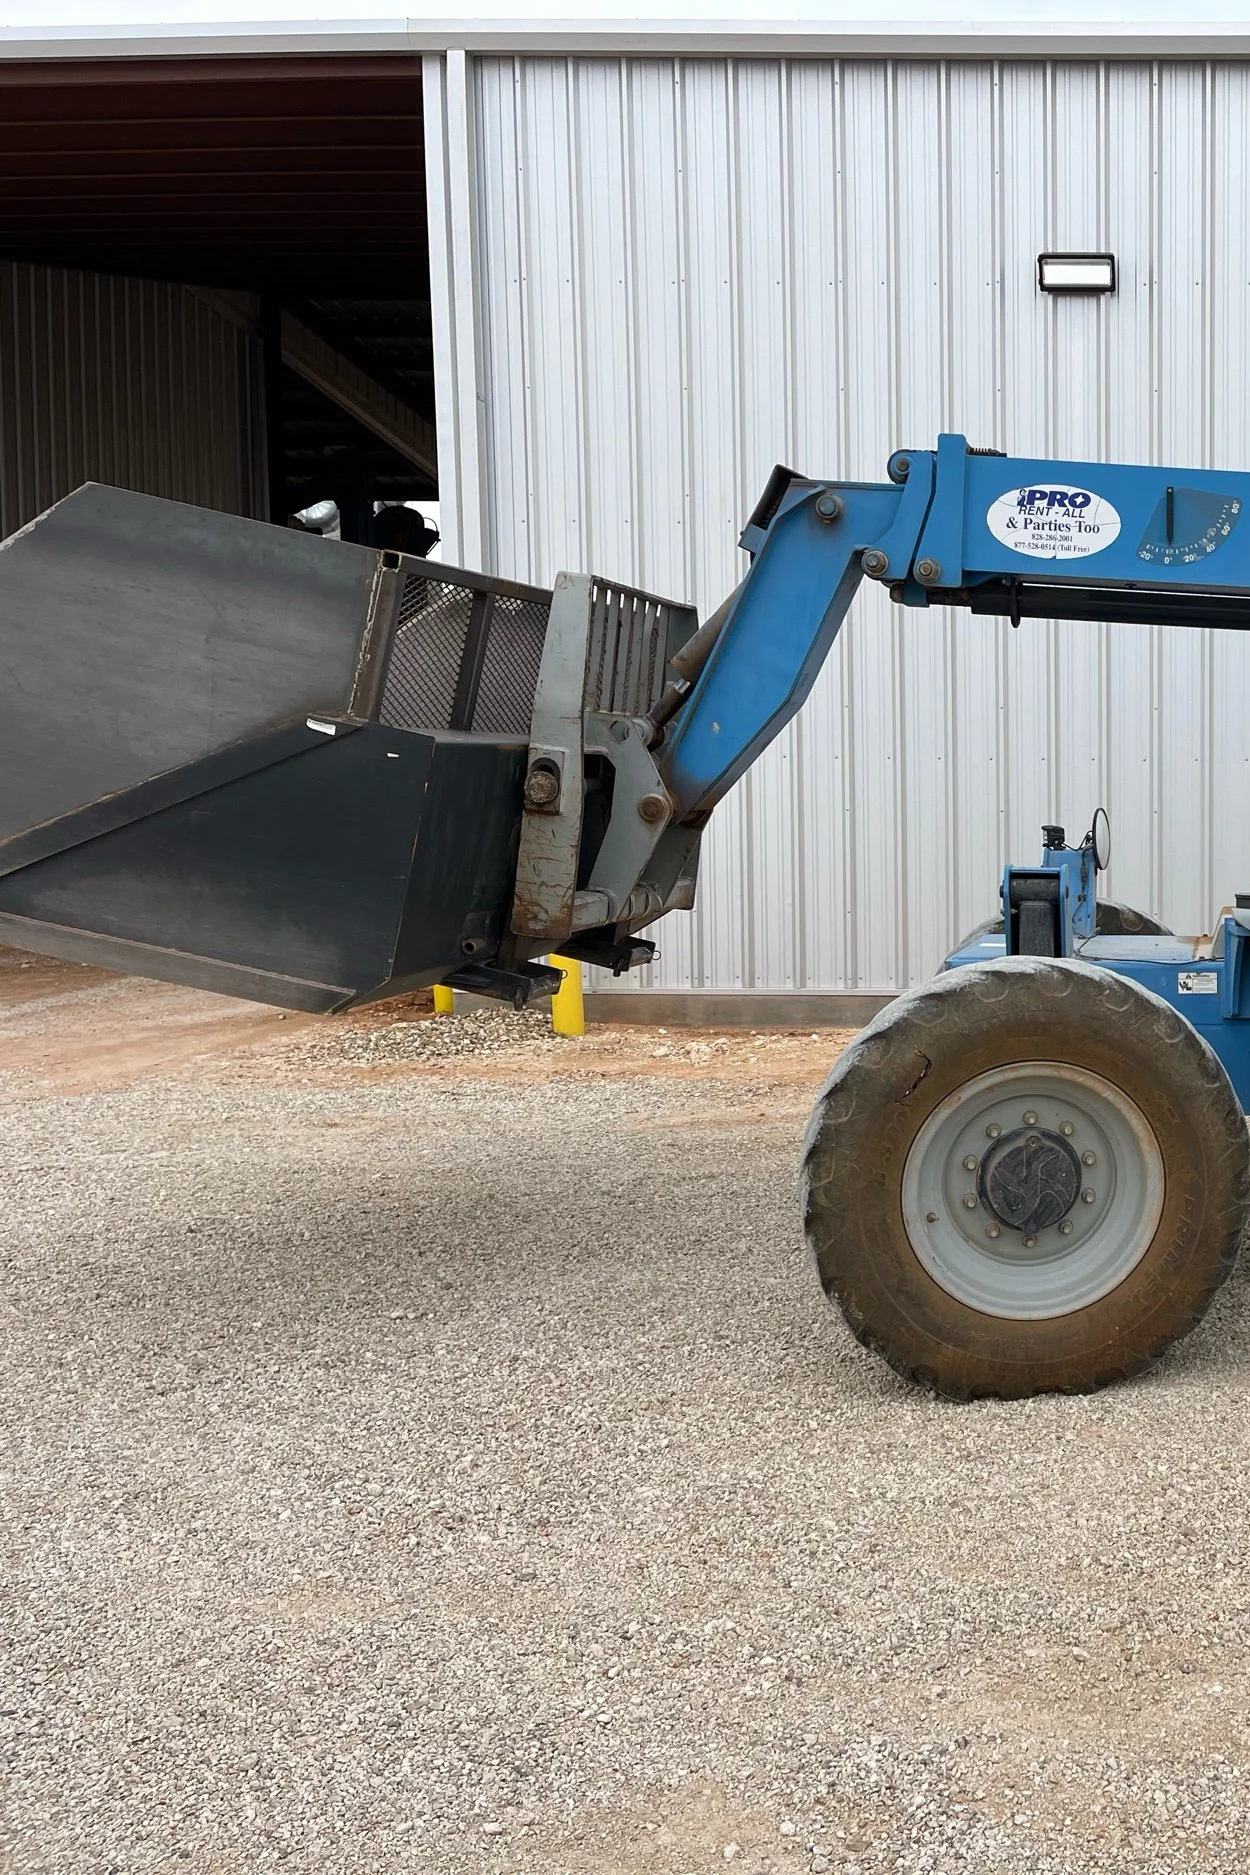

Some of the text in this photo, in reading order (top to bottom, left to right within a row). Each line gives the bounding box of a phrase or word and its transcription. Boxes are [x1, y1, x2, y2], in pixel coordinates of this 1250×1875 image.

[1019, 506, 1052, 516] RENT
[1062, 508, 1085, 518] ALL
[1006, 516, 1100, 534] & Parties Too
[1031, 533, 1073, 543] 828-286-2001
[1057, 544, 1072, 552] (Toll
[1073, 545, 1090, 553] Free)
